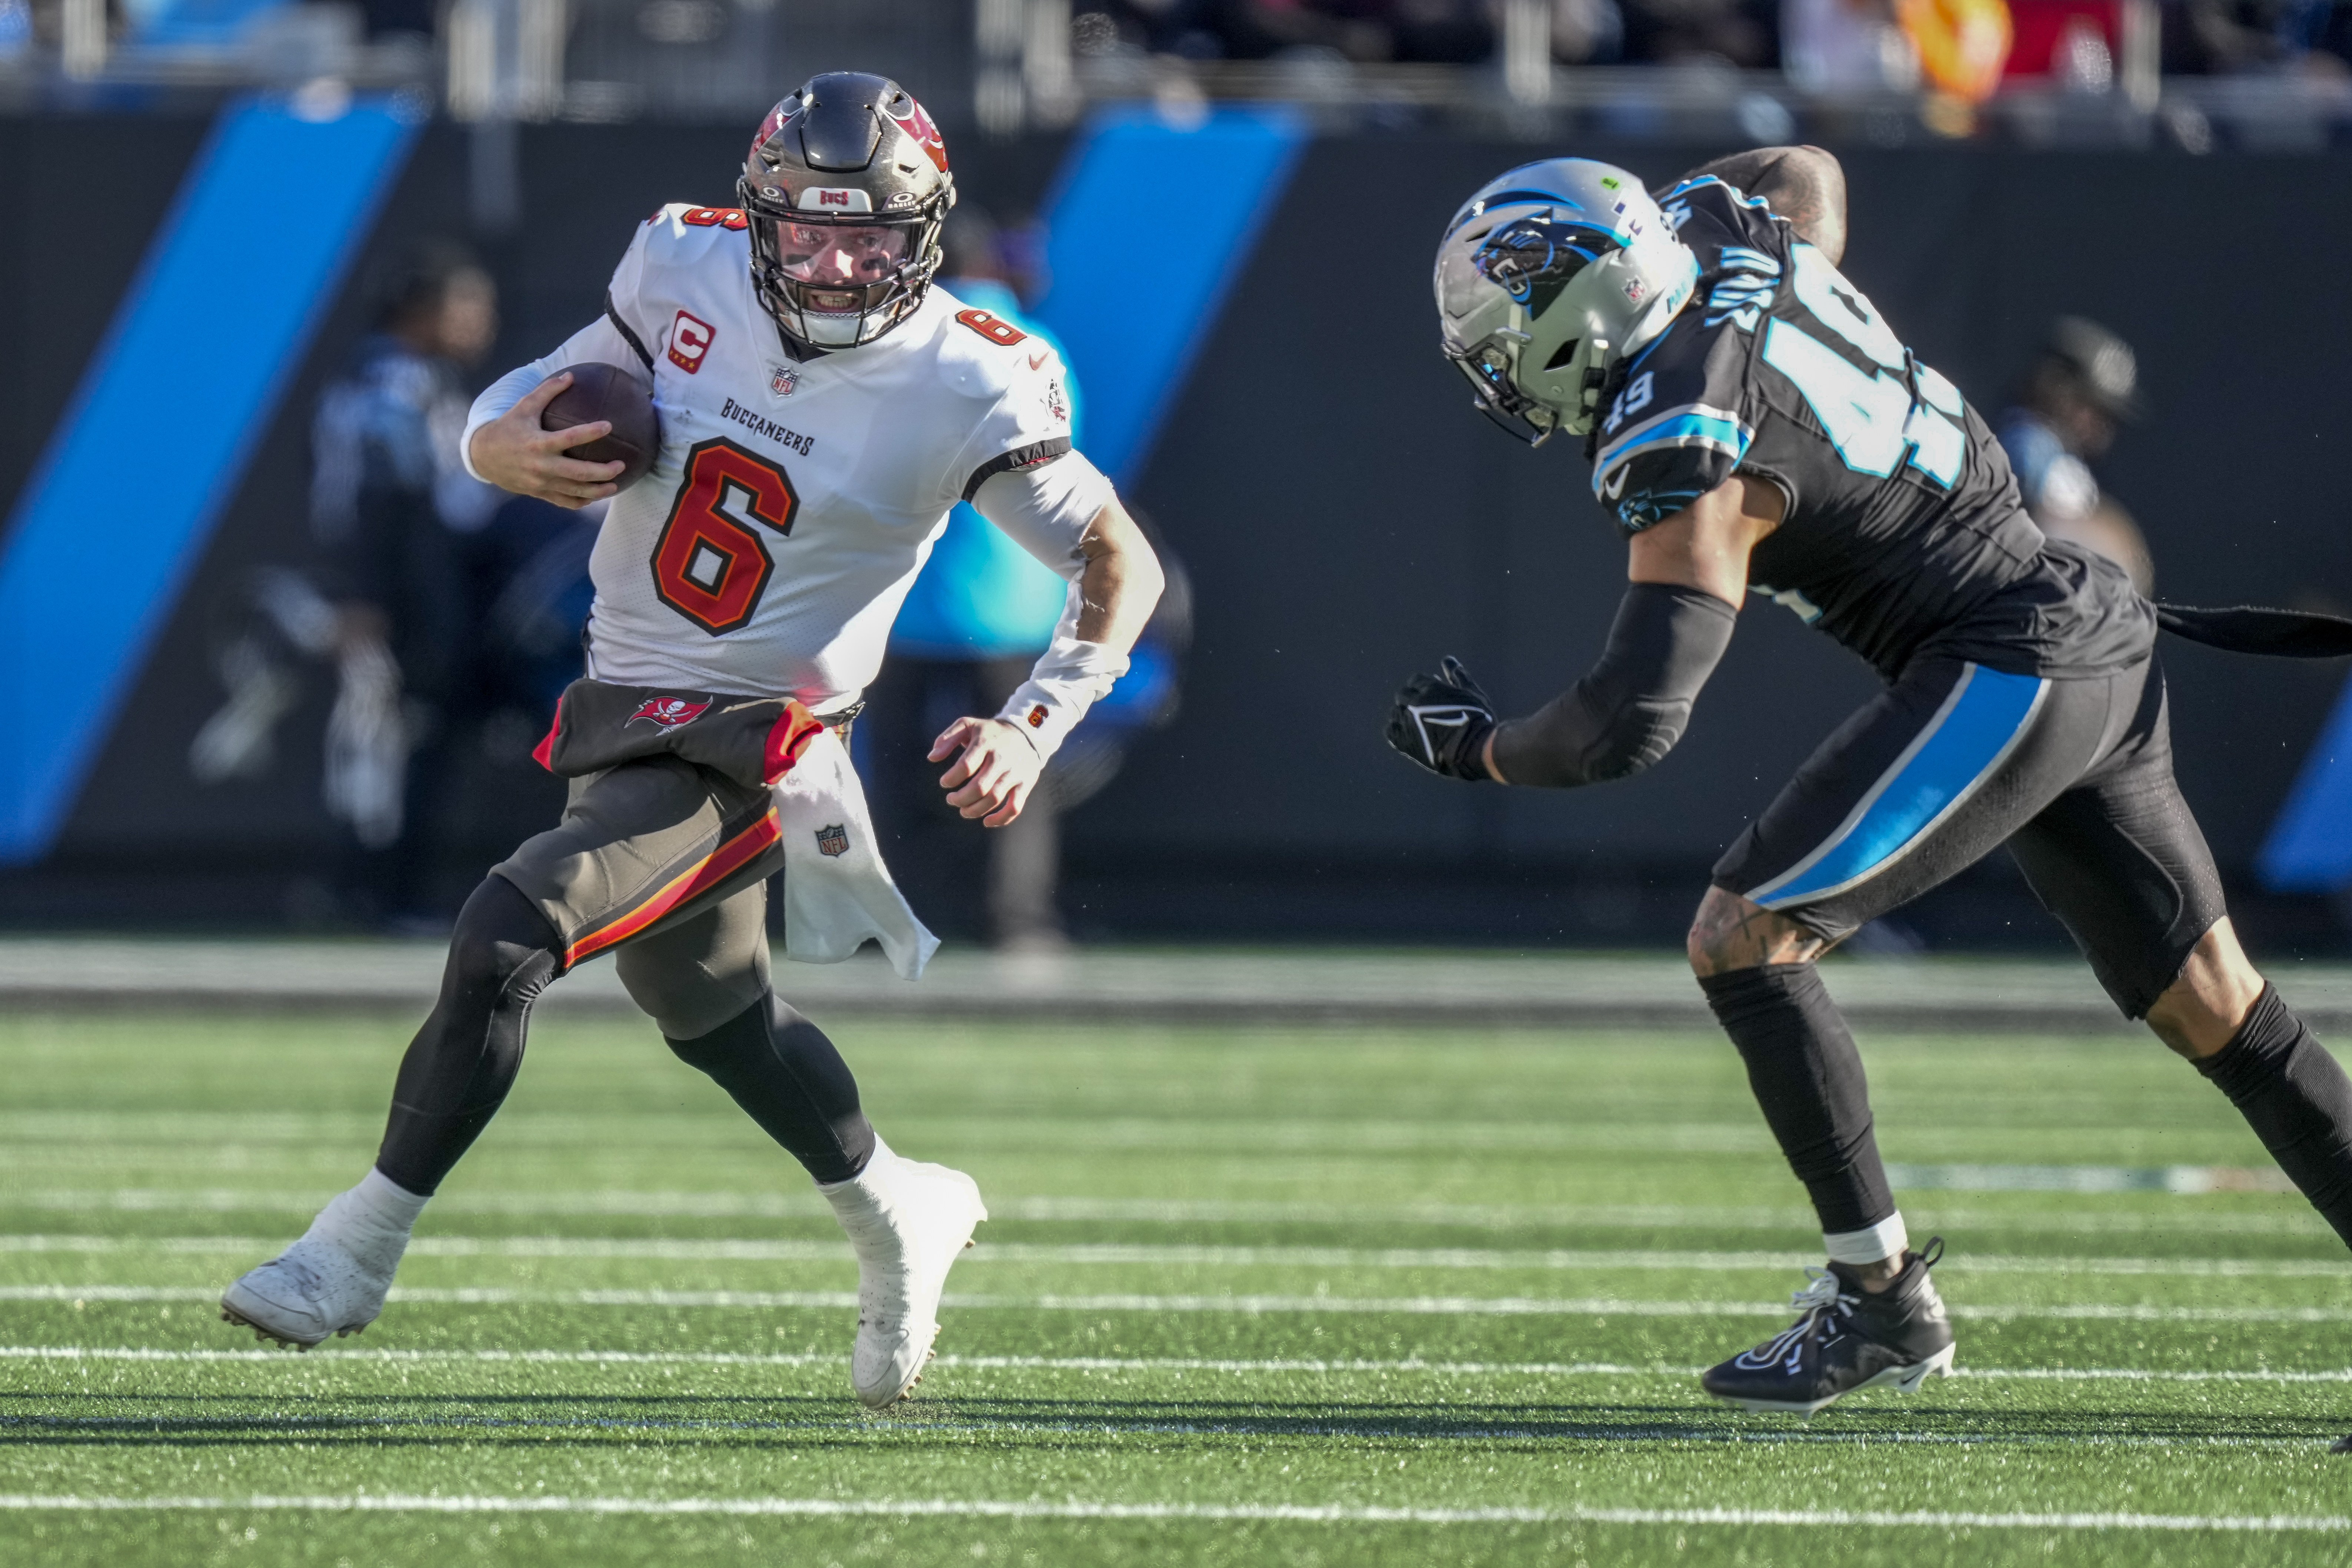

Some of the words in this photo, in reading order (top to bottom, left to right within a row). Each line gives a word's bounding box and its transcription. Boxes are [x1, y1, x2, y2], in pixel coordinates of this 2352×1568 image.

[820, 190, 848, 205] BUCS
[673, 316, 709, 359] C
[955, 309, 1028, 346] 6
[773, 377, 791, 392] NFL
[1602, 371, 1655, 435] 49
[720, 397, 815, 457] BUCCANEERS
[649, 435, 801, 637] 6
[821, 838, 847, 853] NFL
